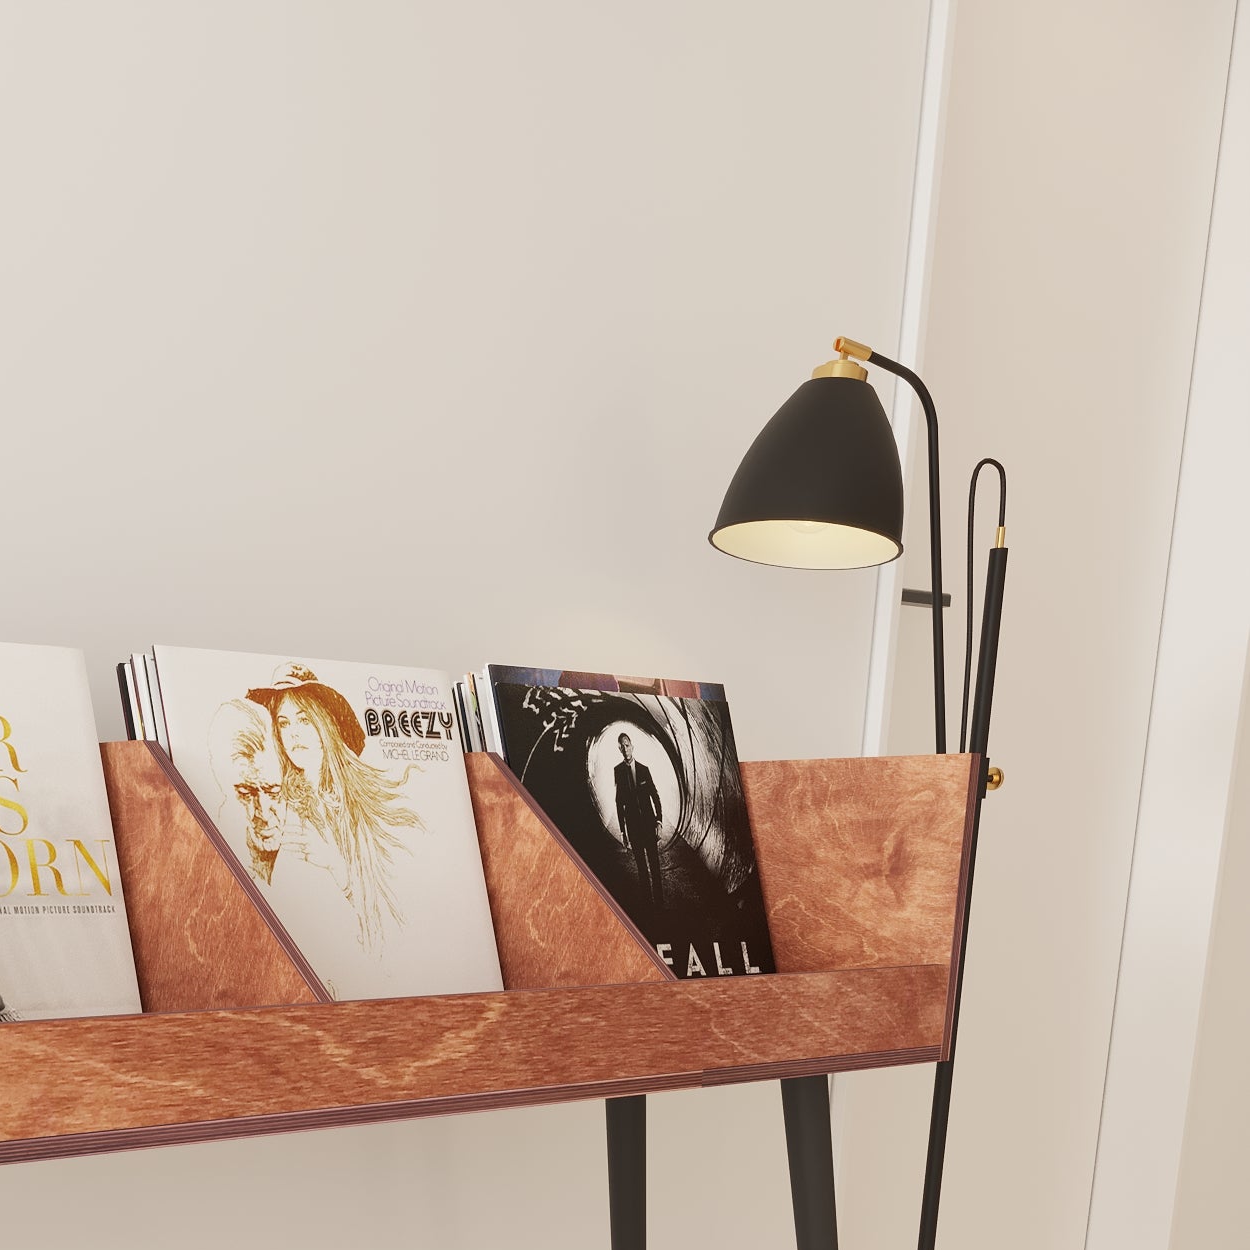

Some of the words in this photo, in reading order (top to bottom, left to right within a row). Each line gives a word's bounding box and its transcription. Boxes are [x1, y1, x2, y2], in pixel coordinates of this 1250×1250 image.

[368, 676, 404, 696] Original
[405, 680, 438, 695] Motion
[365, 691, 396, 707] Picture
[396, 693, 446, 710] Soundtrack
[364, 708, 453, 741] BREEZY
[382, 748, 410, 760] MICHEL
[411, 750, 449, 762] LEGRAND
[14, 906, 40, 914] MOTION
[42, 905, 70, 914] PICTURE
[73, 905, 115, 914] SOUNDTRACK
